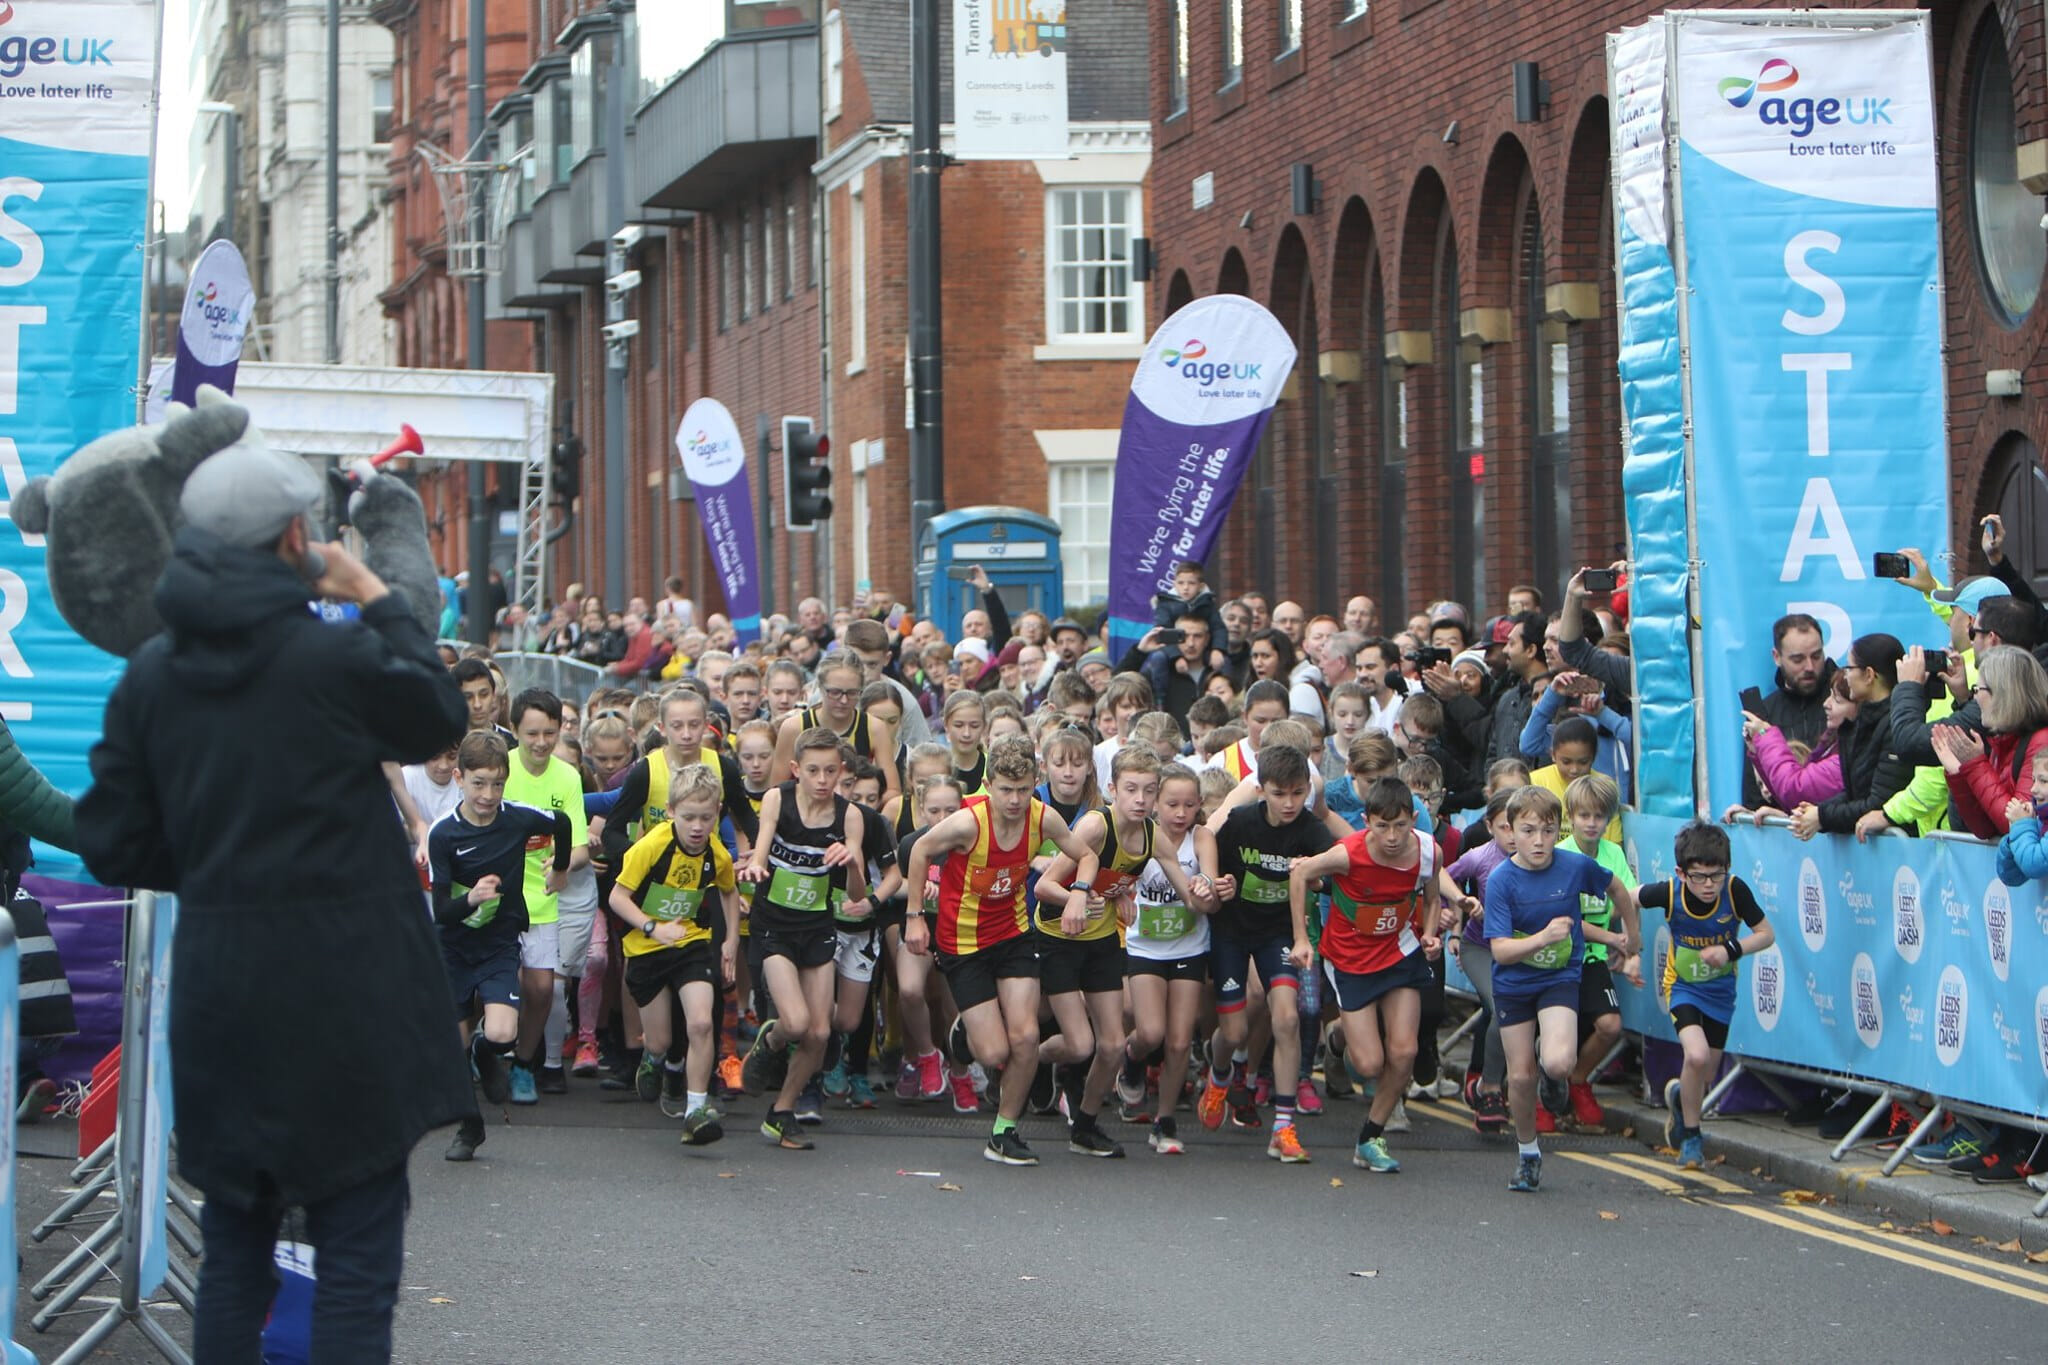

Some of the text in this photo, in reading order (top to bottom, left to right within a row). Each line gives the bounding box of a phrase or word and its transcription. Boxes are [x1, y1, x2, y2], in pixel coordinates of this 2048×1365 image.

[964, 0, 979, 57] Transf
[41, 82, 81, 98] later
[86, 83, 113, 99] life
[966, 81, 1055, 92] Connecting Leeds
[1789, 141, 1897, 157] Love later life
[1199, 389, 1262, 399] Love later life
[1202, 446, 1232, 481] life.
[1136, 442, 1204, 574] We're flying the
[1183, 481, 1215, 528] later
[1171, 528, 1196, 558] for
[990, 877, 1011, 894] 42
[1255, 887, 1288, 899] 150
[785, 887, 817, 905] 179
[659, 899, 692, 915] 203
[1152, 918, 1184, 934] 124
[1375, 916, 1397, 930] 50
[1987, 909, 2006, 928] LEEDS
[1898, 927, 1919, 946] DASH
[1758, 966, 1777, 982] LEEDS
[1856, 981, 1873, 999] LEEDS
[1758, 996, 1776, 1014] DASH
[1940, 995, 1960, 1014] LEEDS
[1858, 1012, 1879, 1032] DASH
[1939, 1012, 1959, 1030] ABBEY
[1938, 1028, 1959, 1048] DASH
